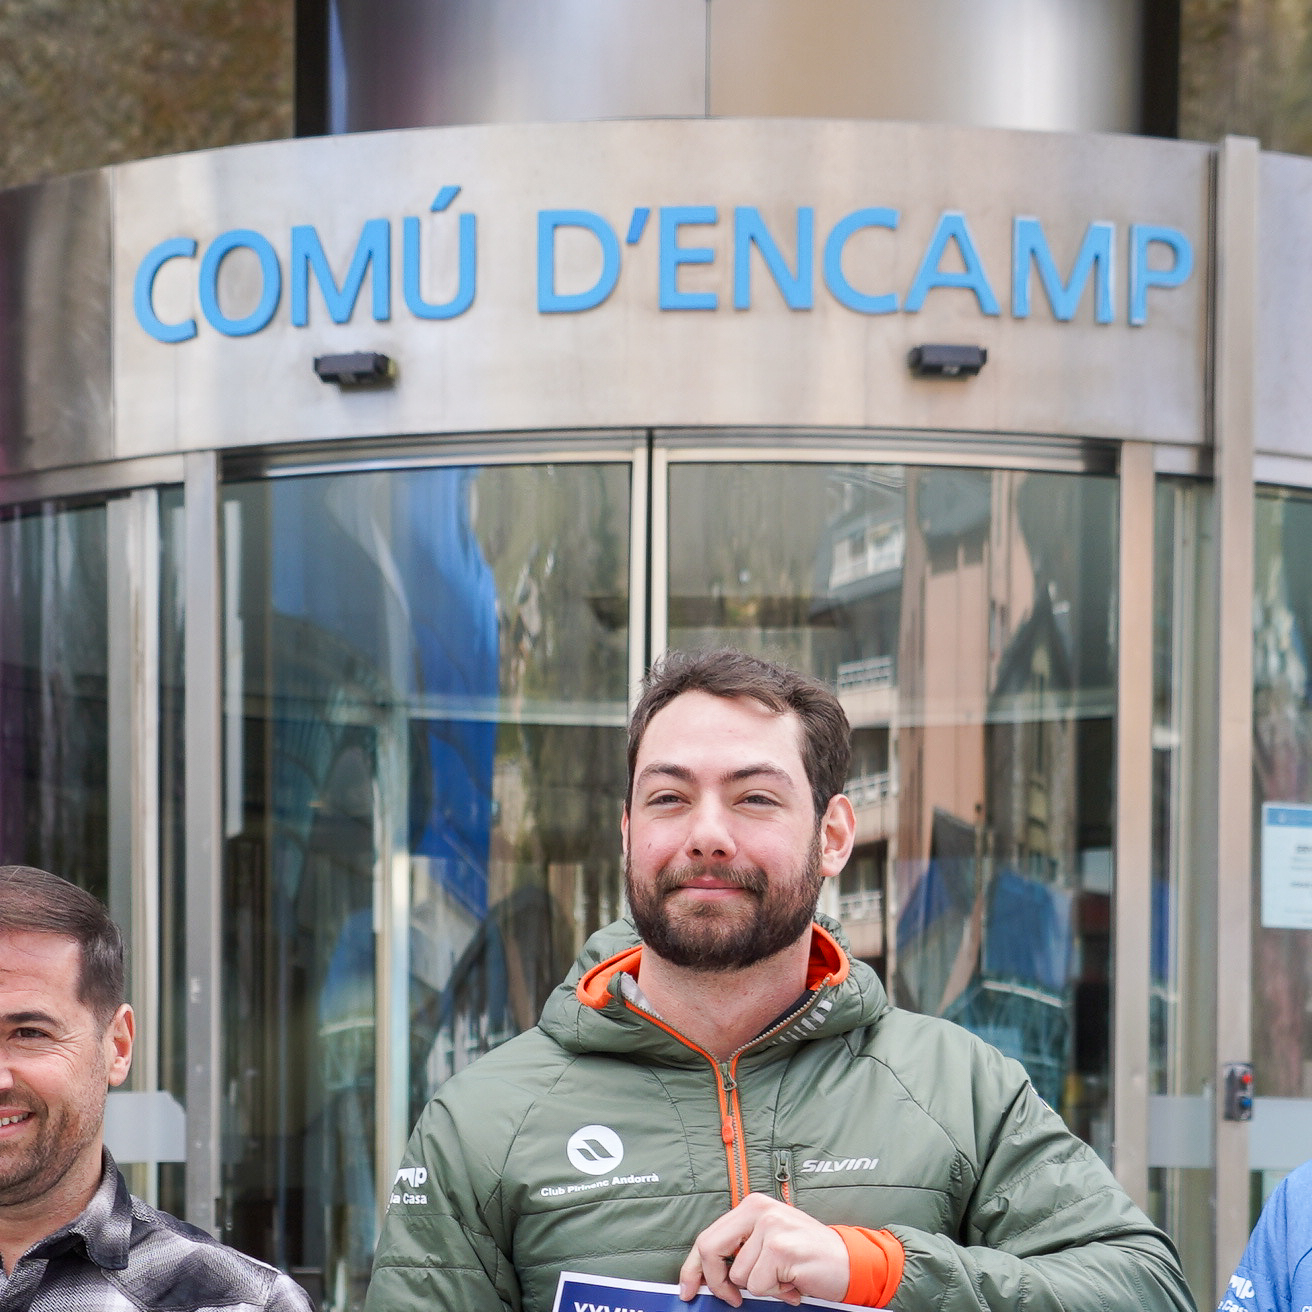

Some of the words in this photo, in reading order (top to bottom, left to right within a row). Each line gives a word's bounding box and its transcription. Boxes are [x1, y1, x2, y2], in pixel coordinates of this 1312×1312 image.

[133, 184, 478, 343] COMÚ
[537, 206, 1195, 327] D'ENCAMP
[540, 1187, 565, 1197] Club
[567, 1179, 610, 1194] Pirinenc
[611, 1172, 659, 1186] Andorrà
[403, 1192, 428, 1205] Casa
